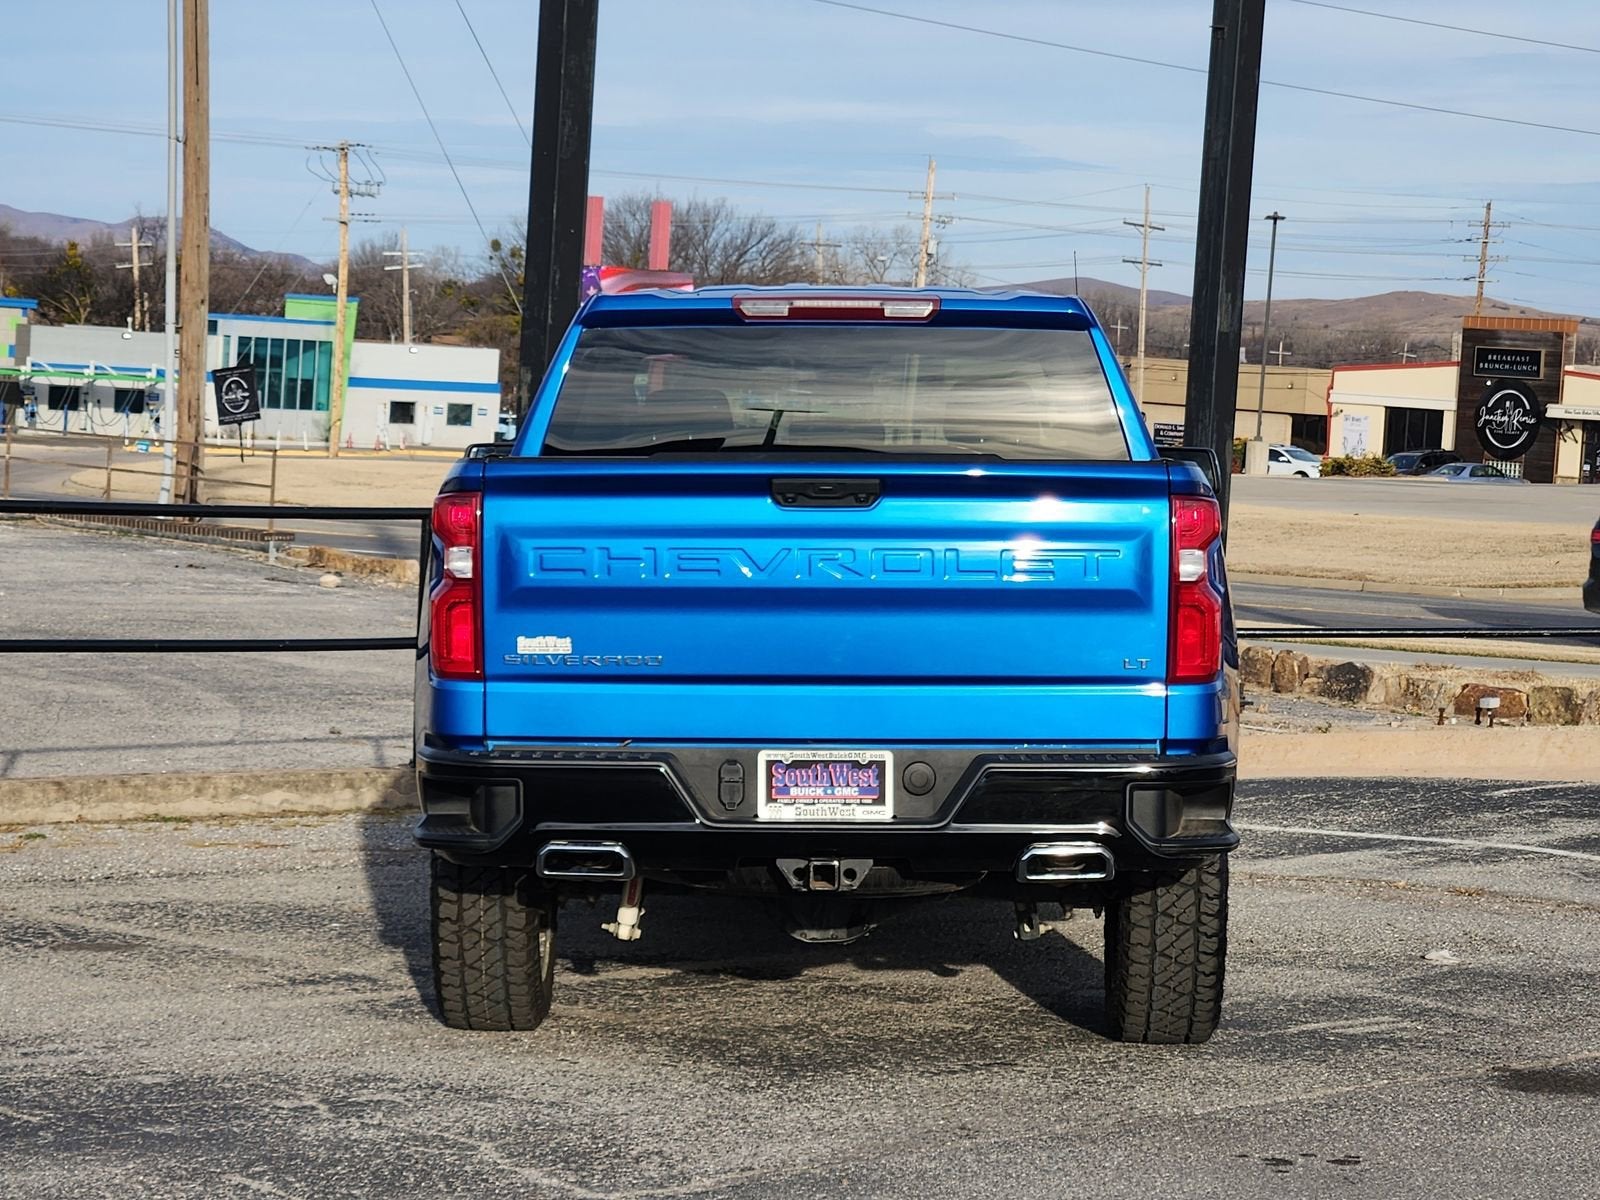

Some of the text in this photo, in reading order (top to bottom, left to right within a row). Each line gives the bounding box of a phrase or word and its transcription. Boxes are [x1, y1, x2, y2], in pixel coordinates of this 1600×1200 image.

[1487, 354, 1530, 362] BREAKFAST
[528, 546, 1121, 582] CHEVROLET
[503, 654, 663, 667] SILVERADO
[1124, 658, 1151, 669] LT
[771, 762, 880, 787] SouthWest
[789, 787, 860, 796] BUICK GMC
[794, 806, 856, 816] SouthWest
